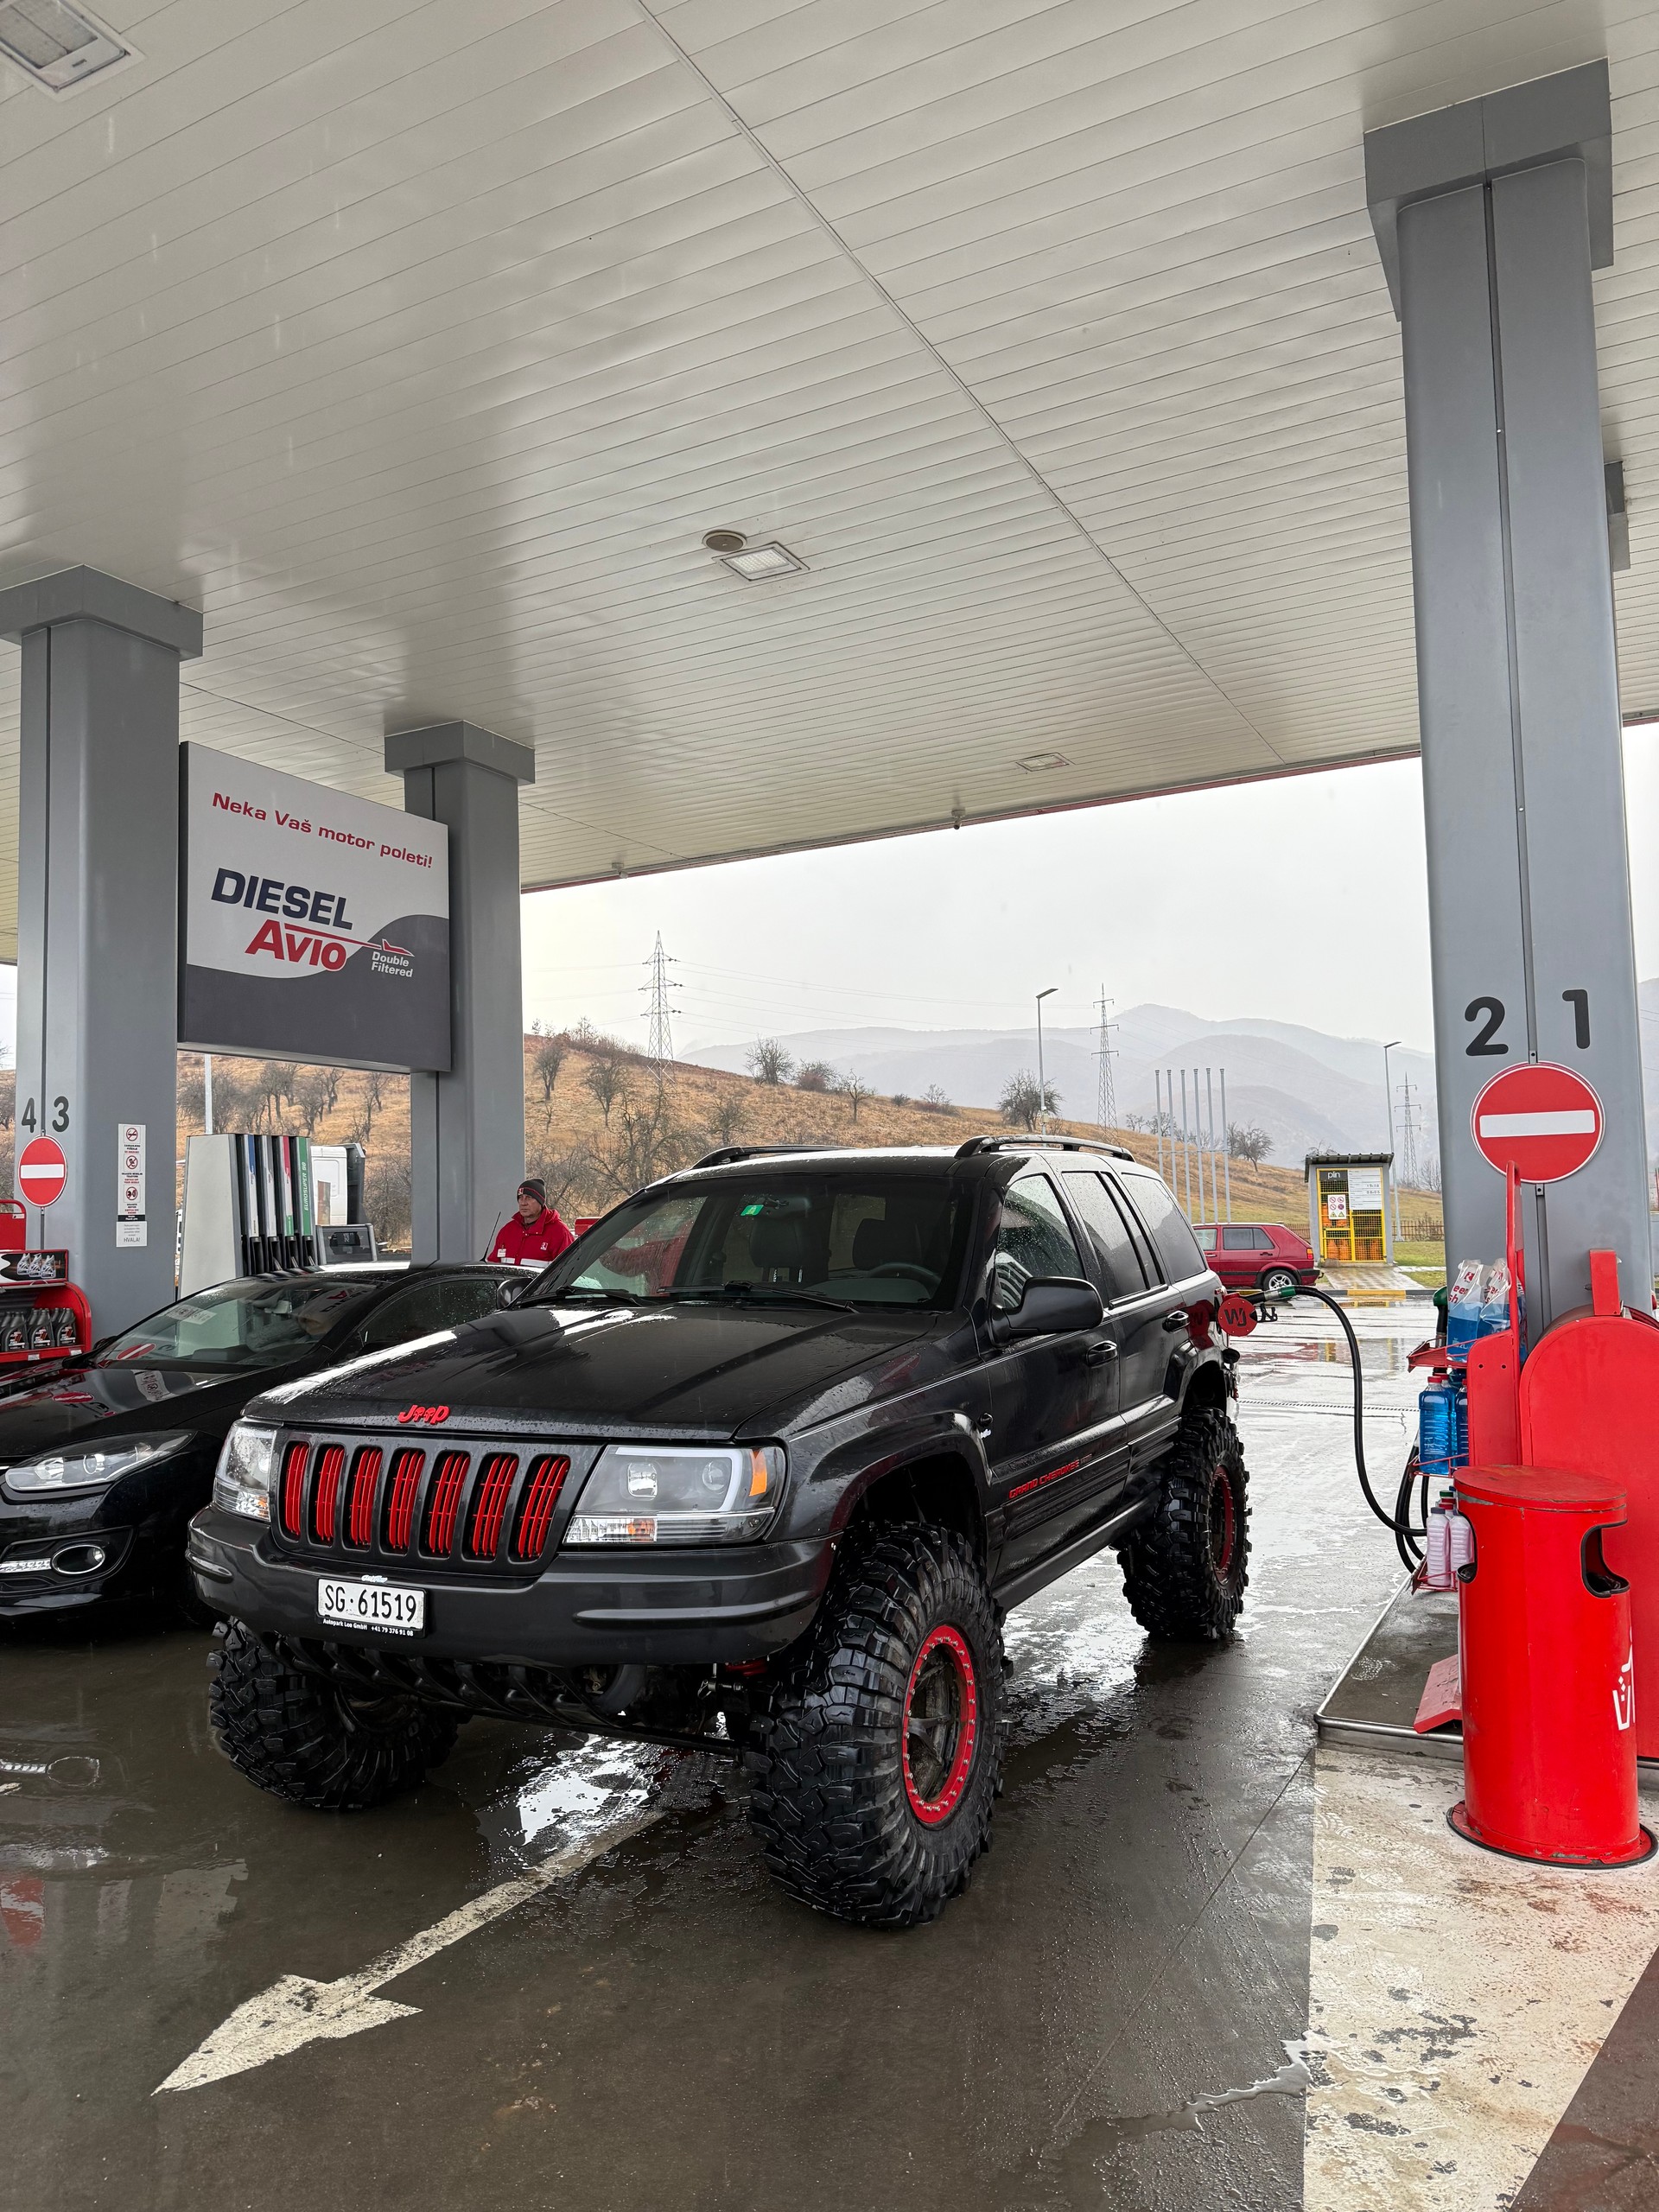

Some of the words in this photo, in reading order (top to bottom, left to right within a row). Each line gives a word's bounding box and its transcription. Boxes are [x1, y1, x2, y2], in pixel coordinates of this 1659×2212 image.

[212, 791, 267, 821] Neka
[274, 810, 312, 834] Vaš
[317, 826, 375, 850] motor
[379, 842, 433, 869] poleti!
[210, 867, 353, 931] DIESEL
[371, 961, 414, 978] Filtered
[372, 950, 410, 967] Double
[1464, 996, 1510, 1057] 2
[1561, 988, 1591, 1050] 1
[21, 1097, 37, 1134] 4
[52, 1096, 70, 1133] 3
[1224, 1306, 1247, 1328] WJ
[1009, 1478, 1038, 1499] GRAND
[1039, 1459, 1079, 1484] CHEROKEE
[323, 1618, 344, 1627] Autopark
[388, 1627, 399, 1636] 376
